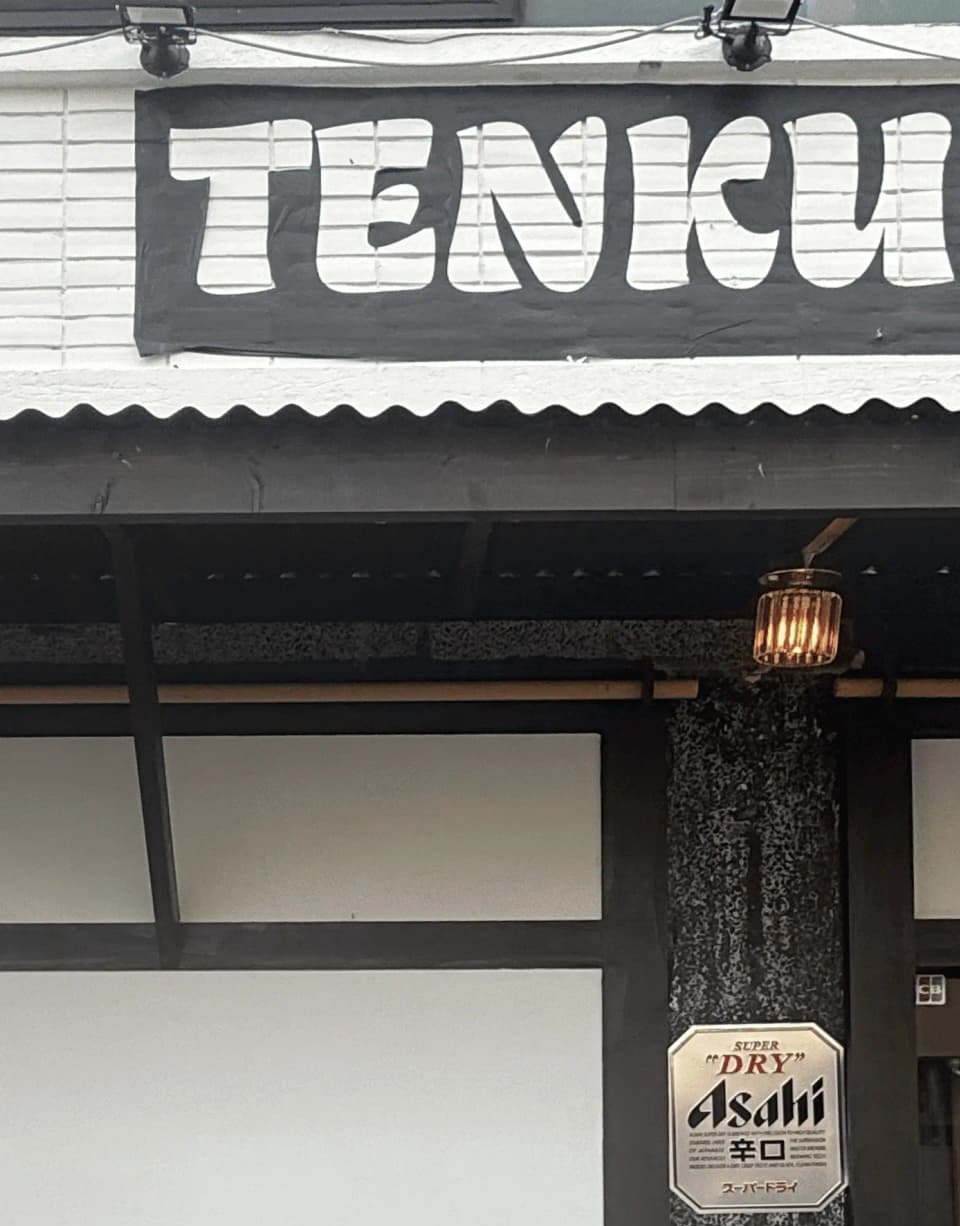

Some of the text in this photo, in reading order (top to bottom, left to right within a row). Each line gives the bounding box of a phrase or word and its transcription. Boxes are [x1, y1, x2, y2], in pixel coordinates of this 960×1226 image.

[733, 1040, 780, 1052] SUPER
[687, 1075, 826, 1130] Asahi
[728, 1137, 786, 1163] 辛口
[721, 1181, 799, 1195] スーパードライ
